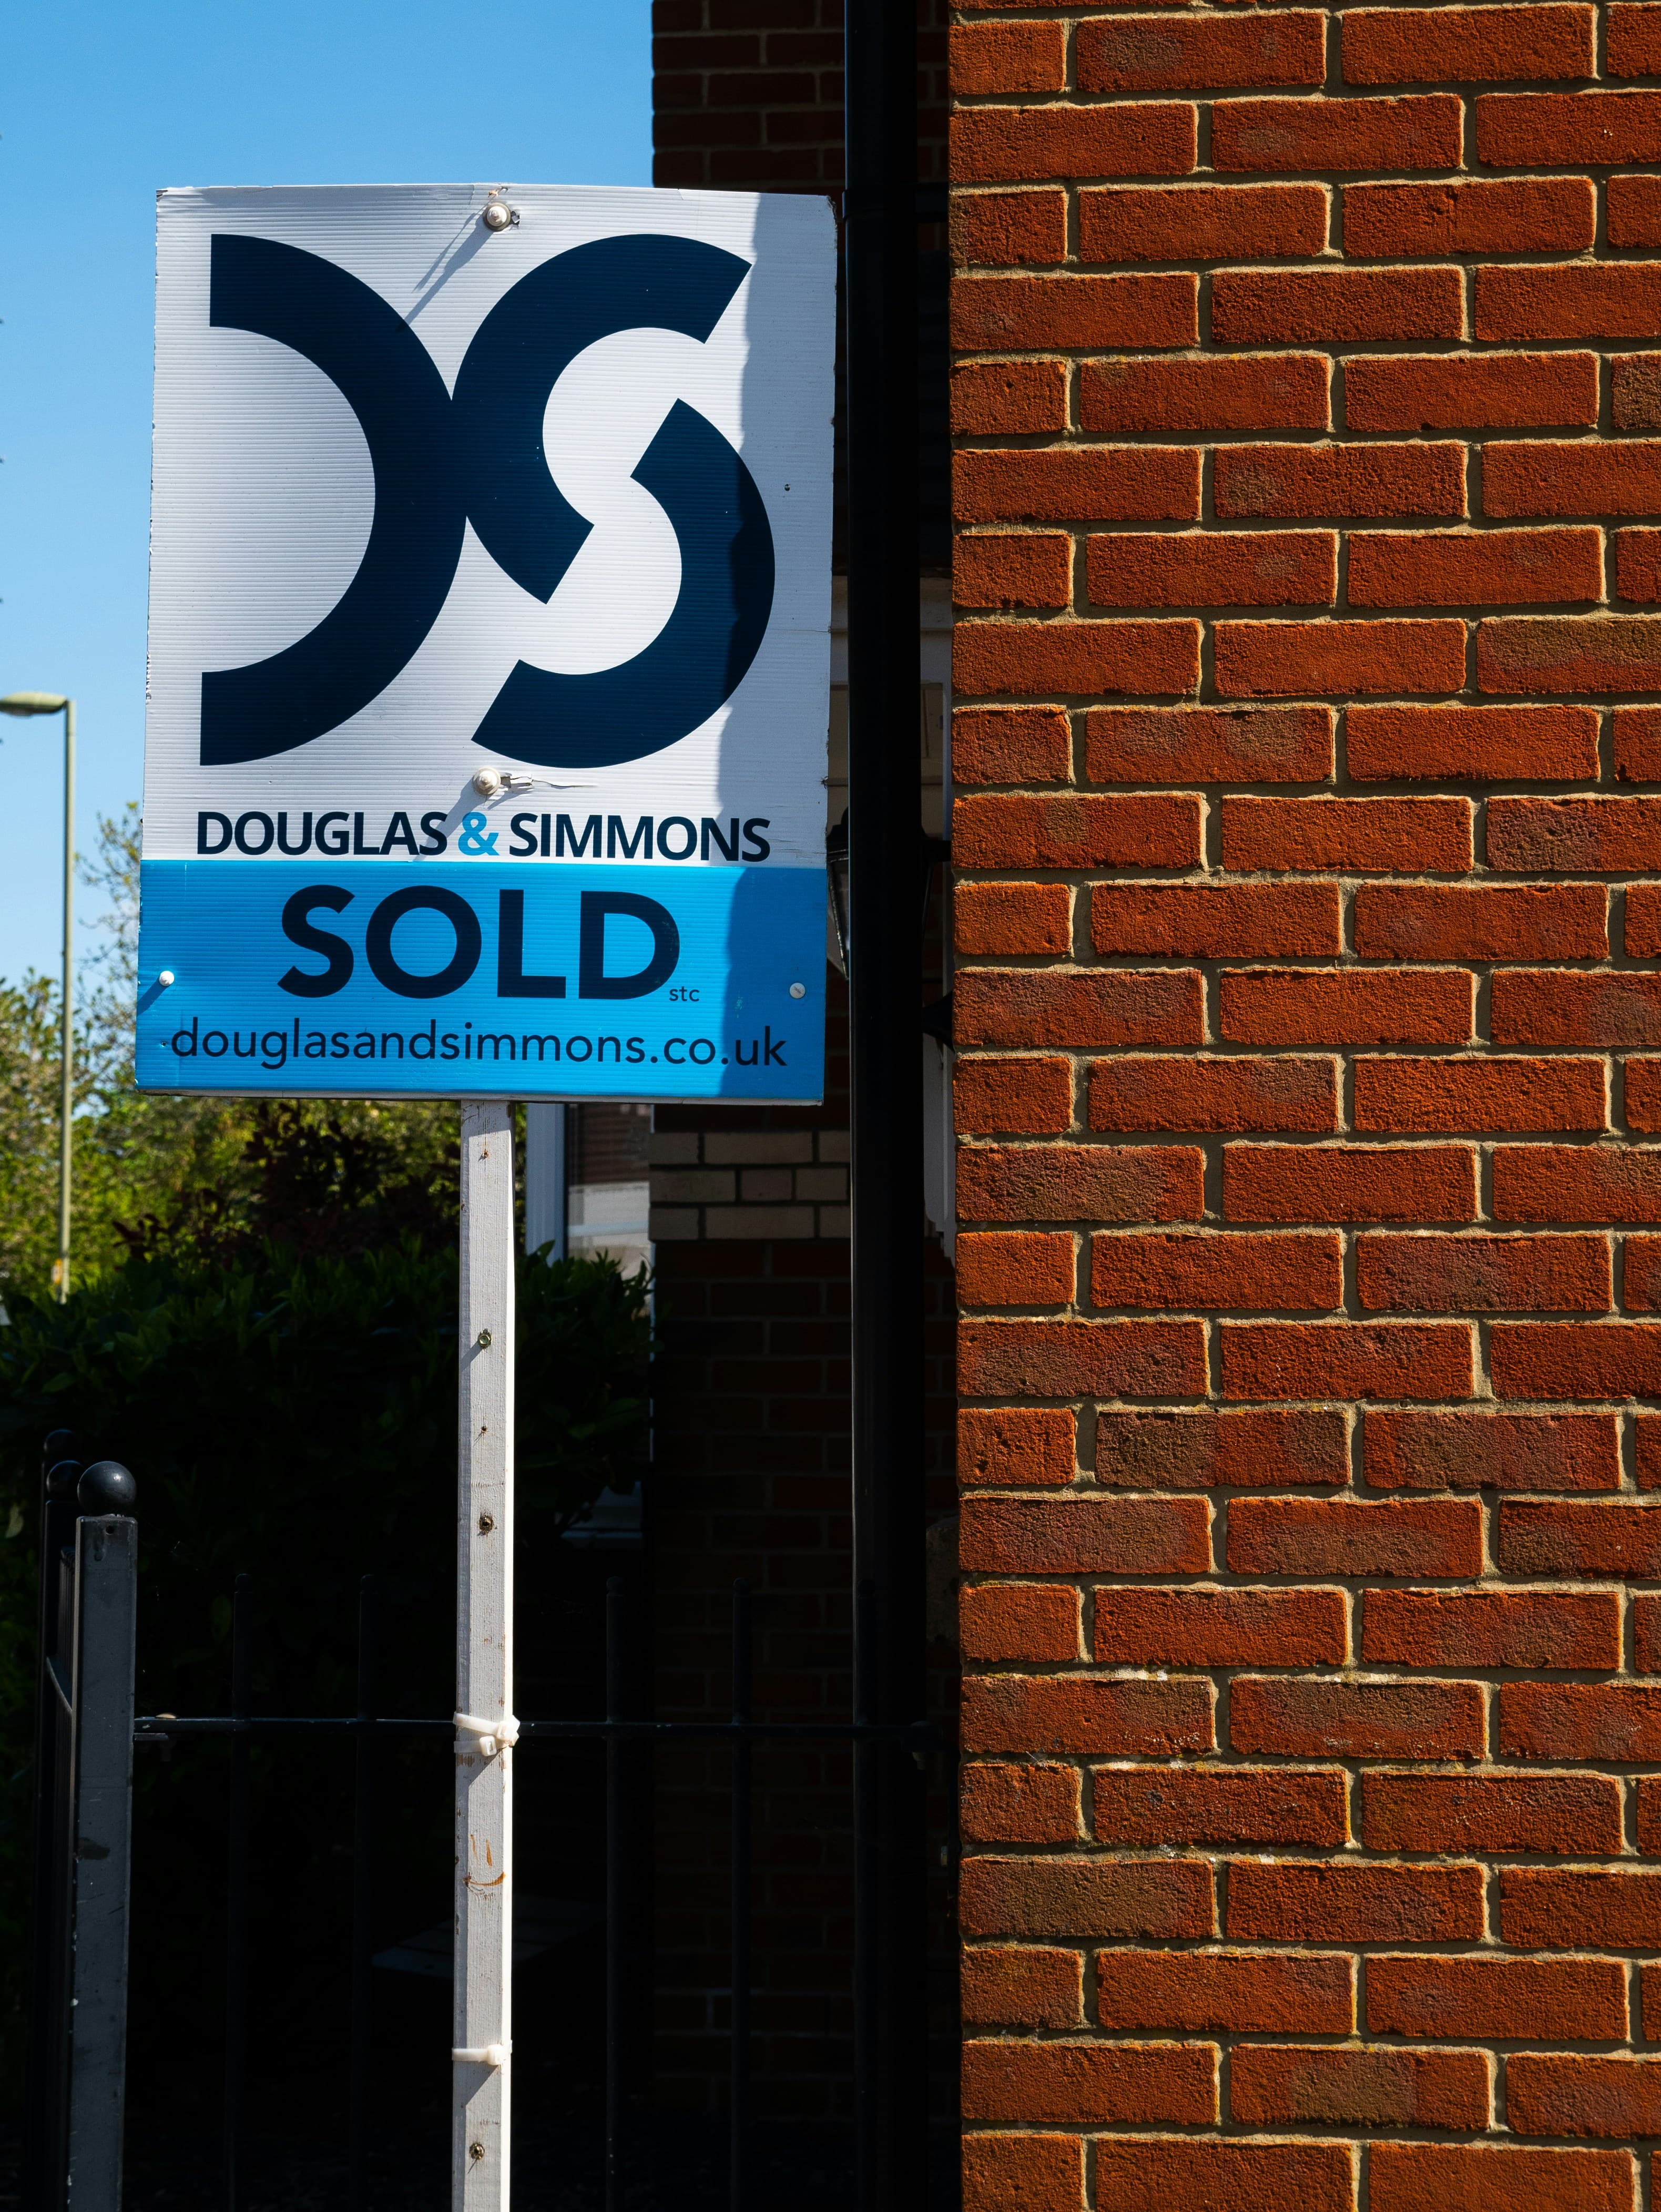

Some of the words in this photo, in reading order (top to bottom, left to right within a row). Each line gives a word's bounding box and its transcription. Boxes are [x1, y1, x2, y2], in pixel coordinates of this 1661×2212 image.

[197, 811, 449, 856] DOUGLAS
[457, 811, 500, 857] &
[509, 812, 771, 862] SIMMONS
[278, 884, 680, 1000] SOLD
[669, 986, 700, 1002] stc
[171, 1016, 788, 1070] douglasandsimmons.co.uk
